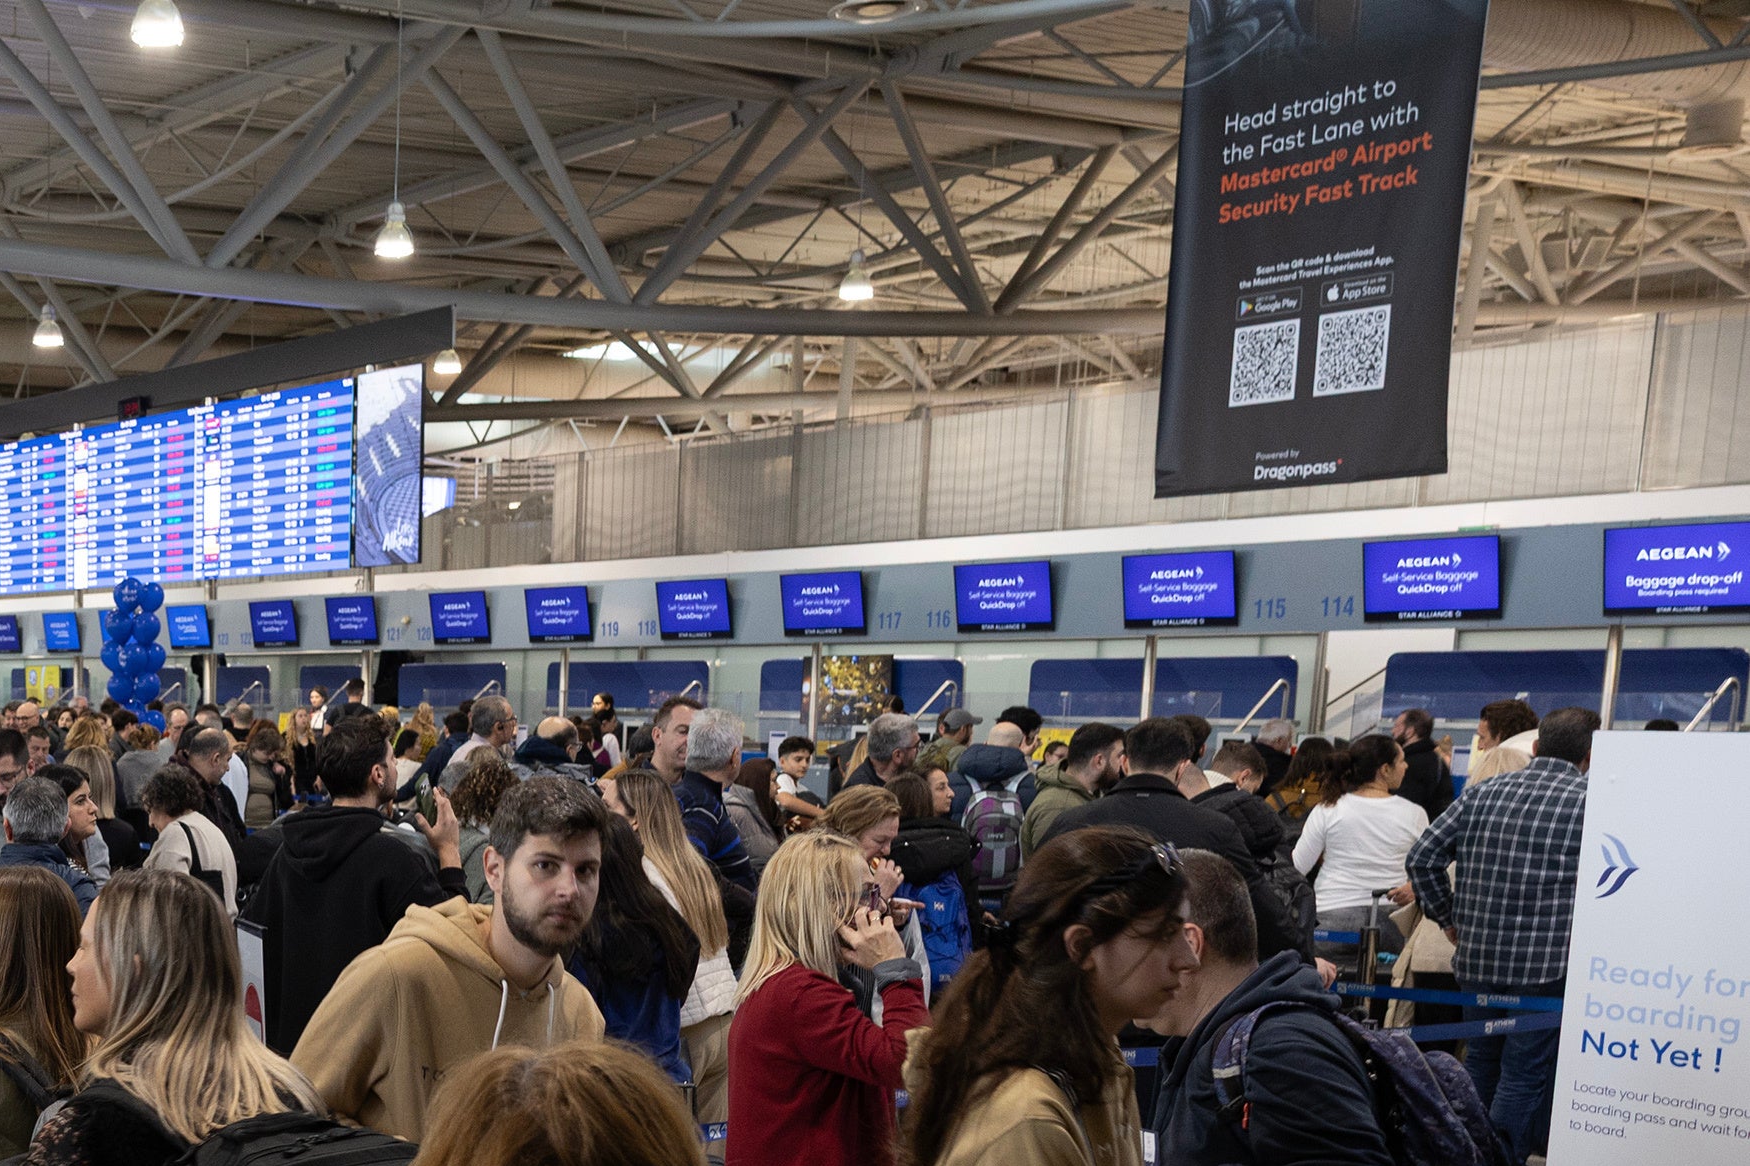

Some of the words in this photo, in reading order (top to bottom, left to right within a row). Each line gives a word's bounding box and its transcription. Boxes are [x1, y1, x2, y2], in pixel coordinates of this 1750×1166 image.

[1224, 102, 1277, 136] Head
[1282, 84, 1368, 122] straight
[1373, 80, 1397, 100] to
[1222, 141, 1255, 165] the
[1260, 129, 1306, 157] Fast
[1311, 118, 1365, 146] Lane
[1370, 101, 1420, 131] with
[1219, 147, 1348, 195] Mastercard®
[1351, 131, 1434, 167] Airport
[1218, 192, 1301, 225] Security
[1304, 180, 1354, 206] Fast
[1357, 164, 1420, 195] Track
[1255, 264, 1276, 276] Scan
[1277, 262, 1290, 272] the
[1290, 258, 1304, 270] QR
[1304, 255, 1324, 267] code
[1333, 245, 1375, 262] download
[1238, 280, 1252, 290] the
[1252, 271, 1297, 288] Mastercard
[1298, 266, 1323, 279] Travel
[1323, 259, 1373, 276] Experiences
[1373, 255, 1395, 267] App.
[1342, 288, 1362, 300] App
[1362, 284, 1387, 297] Store
[1254, 301, 1282, 314] Google
[1282, 297, 1298, 309] Play
[1255, 449, 1290, 461] Powered
[1290, 448, 1300, 460] by
[1254, 461, 1337, 480] Dragonpass
[1636, 546, 1713, 561] AEGEAN
[1397, 556, 1450, 568] AEGEAN
[1150, 568, 1194, 580] AEGEAN
[1382, 572, 1434, 583] Self-Service
[1435, 570, 1479, 583] Baggage
[1625, 575, 1685, 589] Baggage
[1687, 571, 1743, 587] drop-off
[801, 587, 833, 595] AEGEAN
[978, 578, 1016, 588] AEGEAN
[1138, 583, 1181, 593] Self-Service
[1182, 581, 1218, 593] Baggage
[1397, 583, 1449, 595] QuickDrop
[1449, 582, 1463, 593] off
[674, 593, 702, 601] AEGEAN
[1151, 594, 1193, 604] QuickDrop
[1194, 593, 1205, 602] off
[1637, 588, 1674, 597] Boarding
[1675, 589, 1693, 597] pass
[1694, 586, 1729, 596] required
[802, 607, 833, 616] QuickDrop
[979, 601, 1016, 610] QuickDrop
[1254, 597, 1287, 619] 115
[1321, 595, 1355, 617] 114
[878, 611, 902, 630] 117
[927, 610, 951, 628] 116
[1398, 611, 1417, 620] STAR
[1417, 610, 1454, 619] ALLIANCE
[387, 627, 401, 640] 121
[601, 621, 619, 637] 119
[638, 620, 657, 636] 118
[1588, 955, 1694, 999] Ready
[1704, 968, 1750, 998] for
[1347, 984, 1376, 992] ATHENS
[1487, 995, 1520, 1004] ATHENS
[1493, 1018, 1516, 1030] ATHENS
[1584, 992, 1741, 1045] boarding
[1581, 1029, 1640, 1061] Not
[1650, 1037, 1702, 1070] Yet
[1714, 1047, 1723, 1073] !
[1573, 1080, 1617, 1097] Locate
[1619, 1089, 1649, 1102] your
[1652, 1092, 1717, 1117] boarding
[1571, 1099, 1632, 1123] boarding
[1634, 1111, 1666, 1126] pass
[1668, 1117, 1698, 1131] and
[1700, 1122, 1731, 1137] wait
[1569, 1119, 1582, 1130] to
[1584, 1121, 1627, 1139] board.
